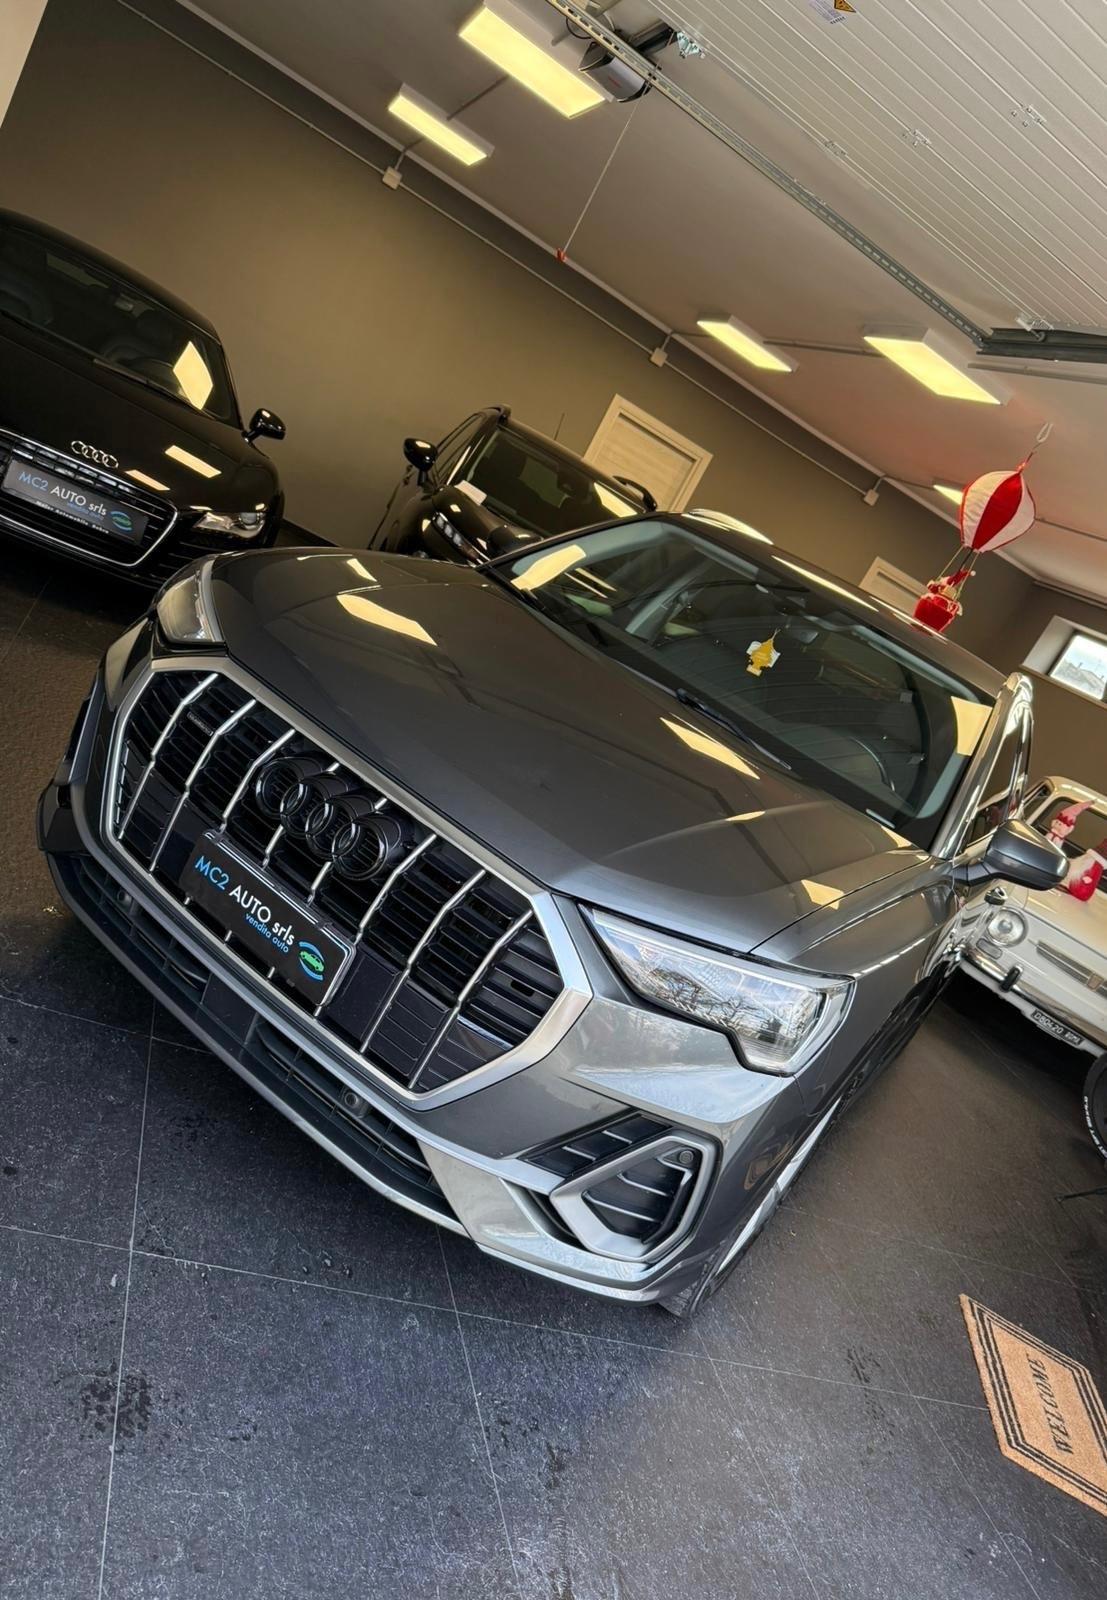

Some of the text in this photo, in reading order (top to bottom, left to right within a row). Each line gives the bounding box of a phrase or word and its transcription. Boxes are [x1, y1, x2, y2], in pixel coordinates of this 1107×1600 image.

[18, 472, 49, 492] MC2
[50, 486, 87, 506] AUTO
[88, 503, 107, 516] srls
[195, 856, 295, 945] MC2 AUTO srls
[245, 913, 289, 953] vendita auto
[1026, 1352, 1074, 1455] WELCOME
